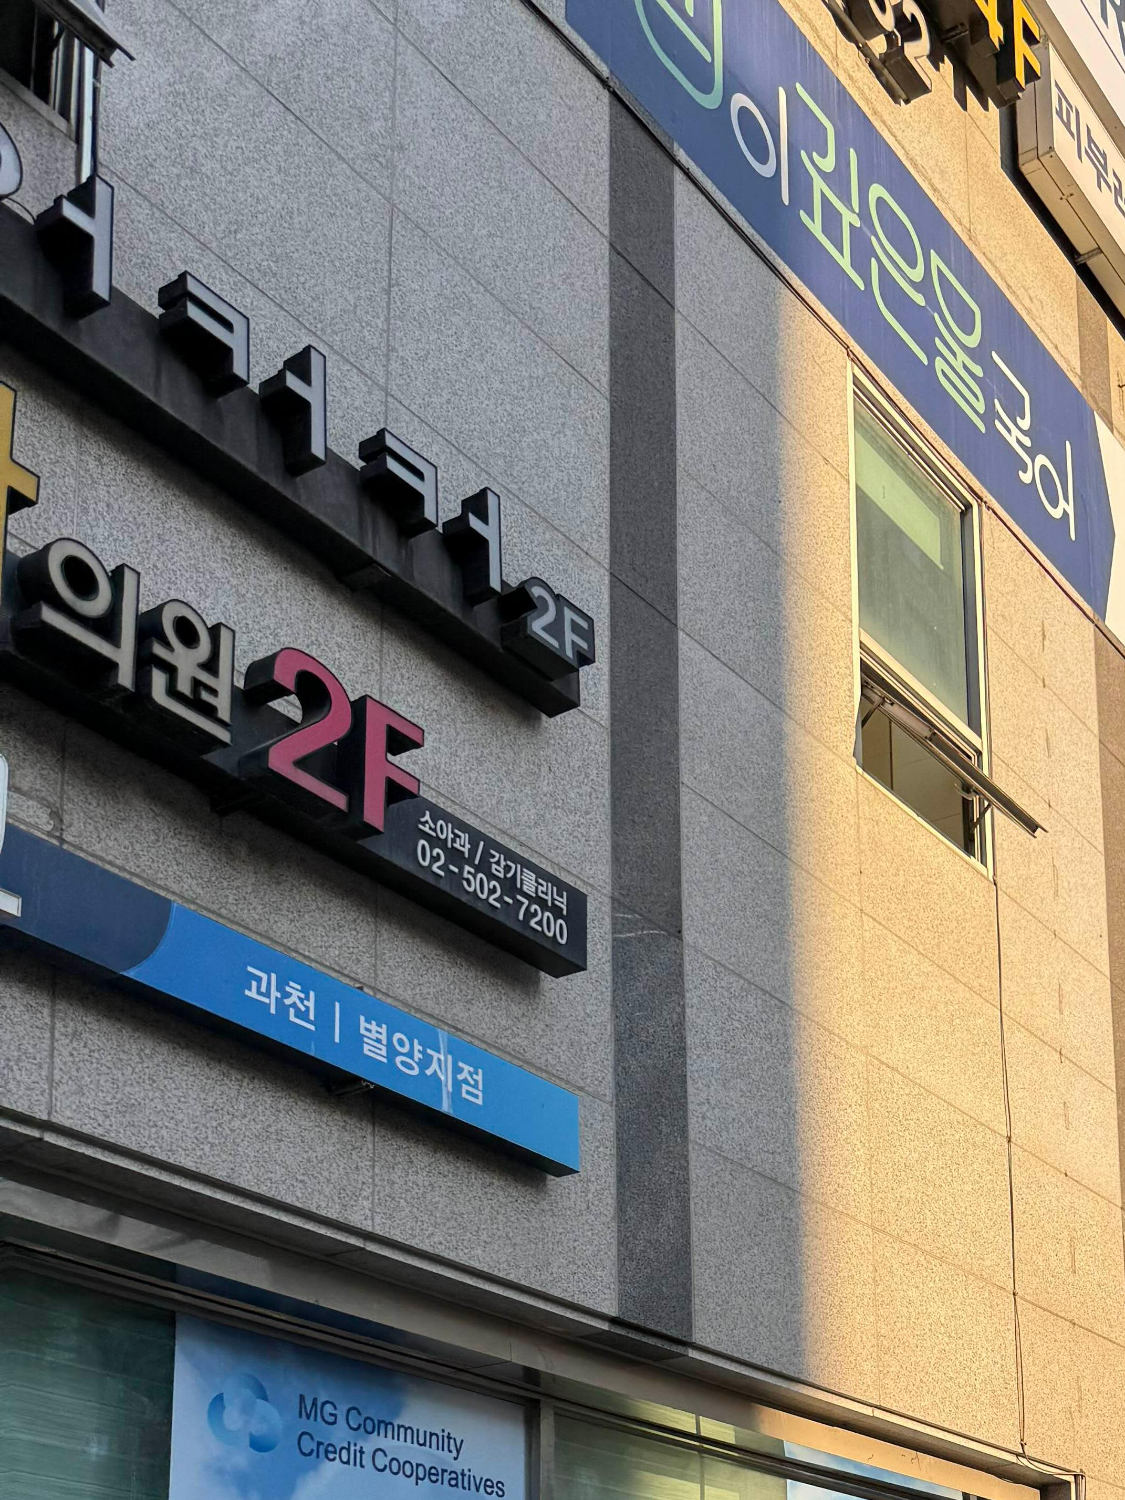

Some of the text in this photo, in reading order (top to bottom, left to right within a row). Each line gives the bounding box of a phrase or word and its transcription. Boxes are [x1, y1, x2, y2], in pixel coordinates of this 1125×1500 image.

[526, 585, 592, 662] 2F
[39, 537, 425, 834] 의원 2F
[416, 838, 568, 945] 02-502-7200
[417, 810, 471, 859] 소아과
[489, 849, 567, 917] 감기클리닉
[244, 965, 484, 1106] 과천 별양지점
[296, 1430, 506, 1499] Credit Cooperatives
[297, 1393, 465, 1461] MG Community
